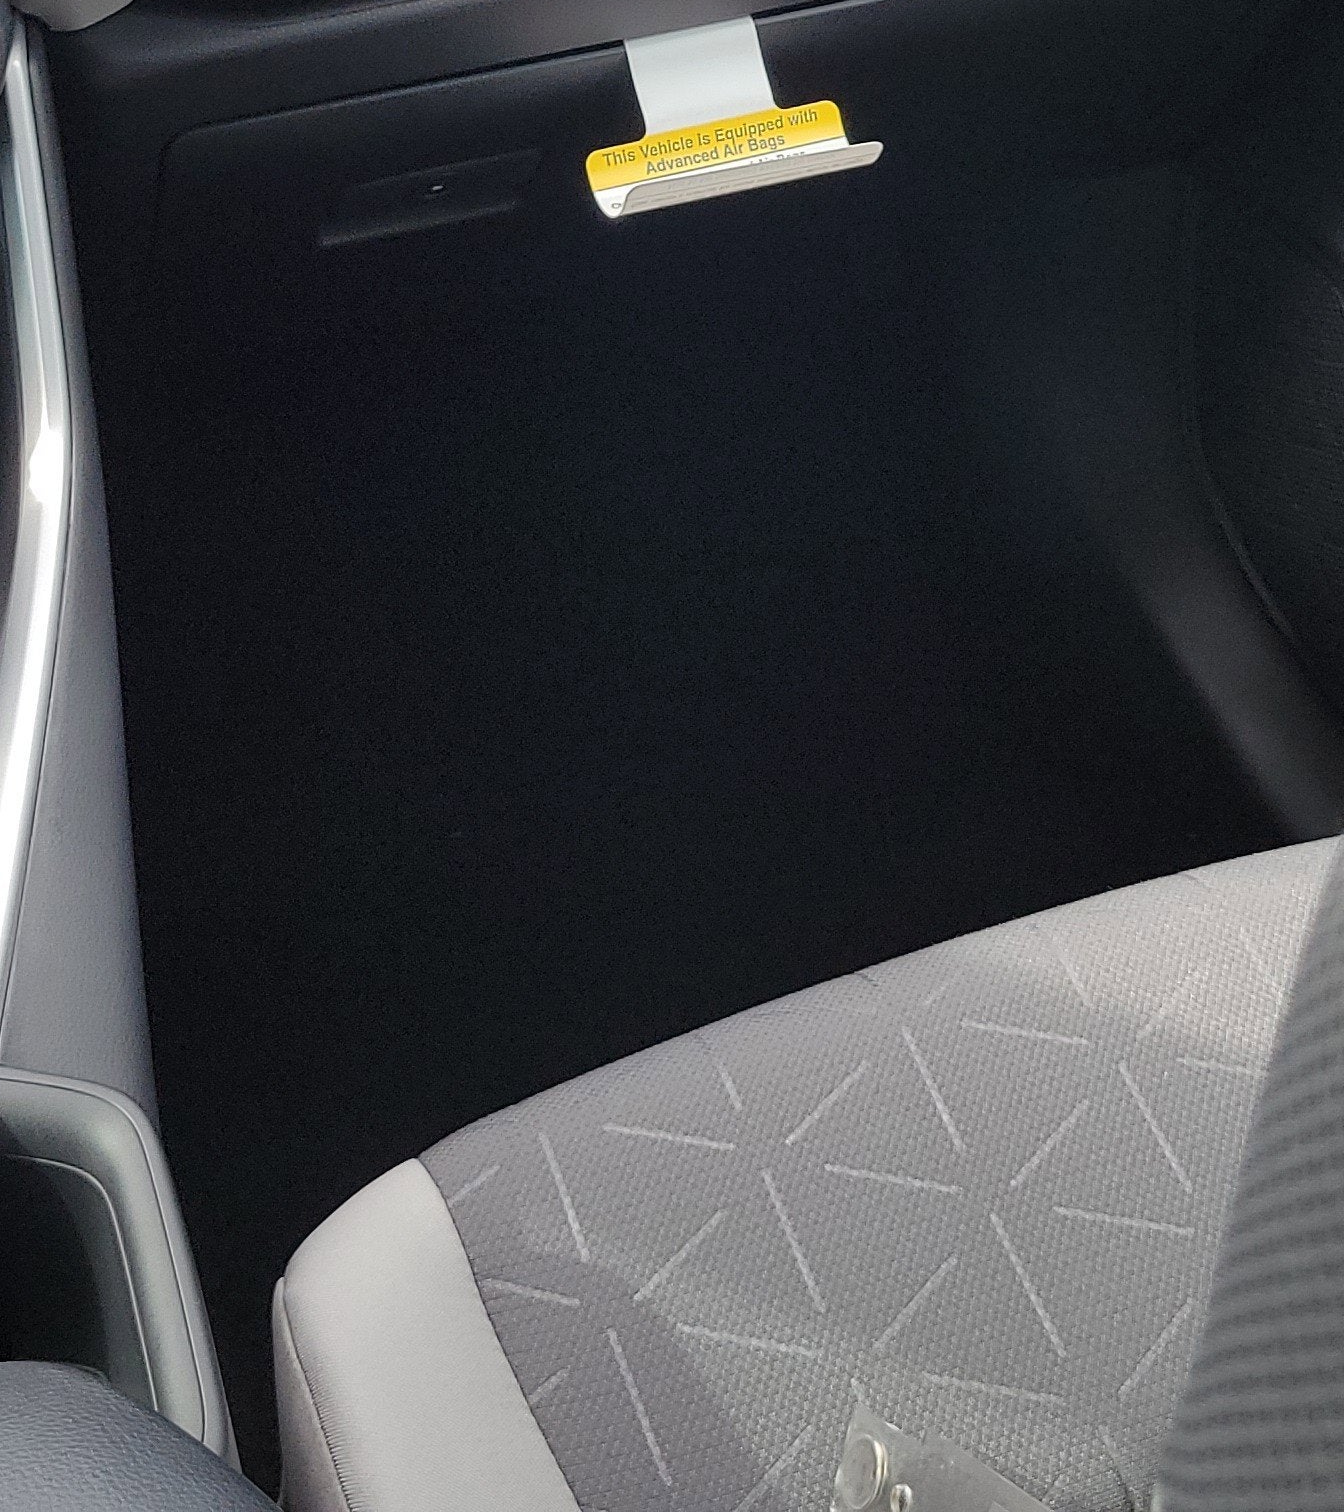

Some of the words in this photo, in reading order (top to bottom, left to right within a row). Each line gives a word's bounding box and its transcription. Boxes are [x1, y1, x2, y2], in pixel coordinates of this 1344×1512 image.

[602, 150, 636, 168] This
[639, 136, 693, 159] Vehicle
[714, 115, 784, 145] Equipped
[787, 108, 818, 126] with
[646, 149, 719, 176] Advanced
[723, 142, 743, 159] Air
[748, 135, 785, 152] Bags
